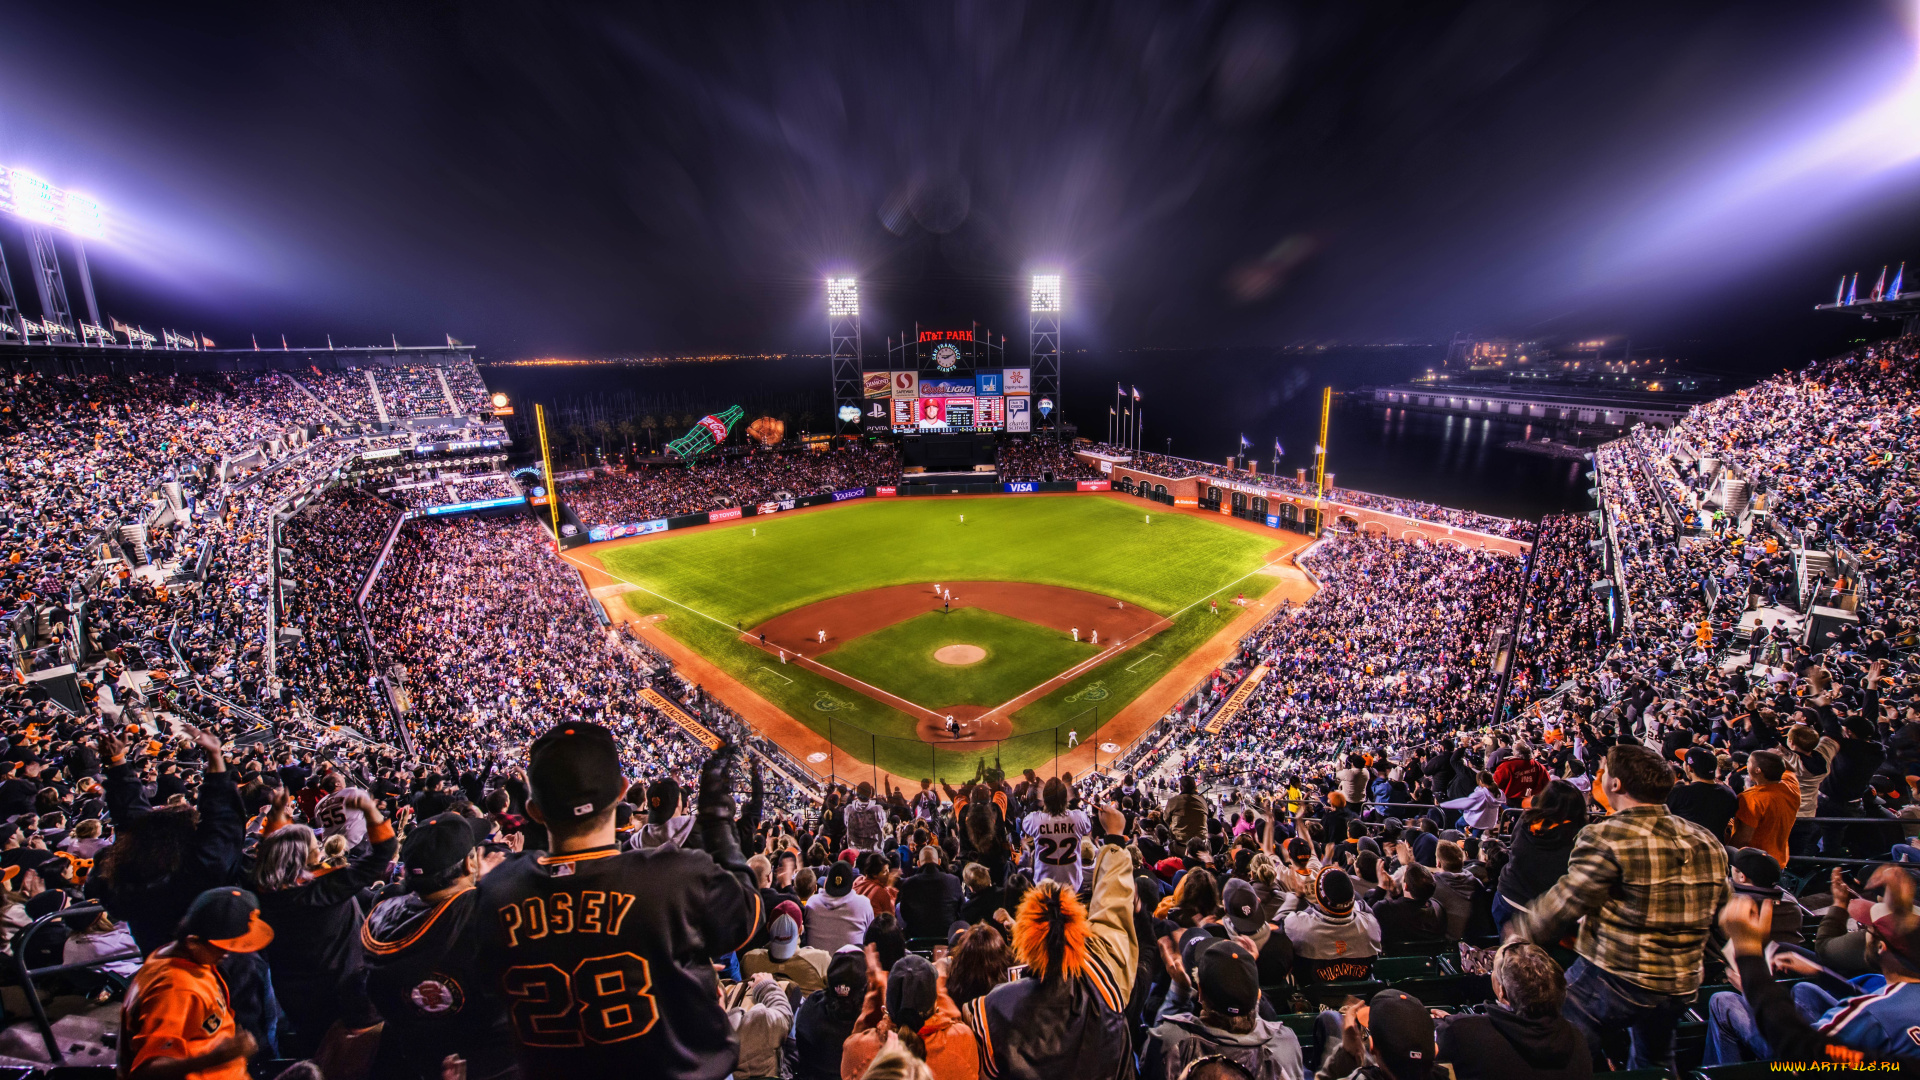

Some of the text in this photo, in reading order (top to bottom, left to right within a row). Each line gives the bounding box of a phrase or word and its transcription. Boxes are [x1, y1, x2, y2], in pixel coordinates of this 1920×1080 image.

[918, 330, 973, 343] AT&T PARK
[931, 342, 961, 361] SAN FRANCISCO
[936, 364, 957, 373] GIANTS
[865, 378, 889, 388] DIAMOND
[946, 385, 973, 393] LIGHT
[510, 466, 541, 479] Ghirardelli
[1010, 483, 1033, 492] VISA
[1231, 483, 1268, 498] LANDING
[719, 510, 741, 519] TOYOTA
[1209, 707, 1235, 729] WELCOME
[1228, 700, 1240, 708] TO
[1241, 680, 1257, 692] PARK
[648, 694, 662, 706] SAN
[657, 701, 691, 725] FRANCISCO
[685, 722, 712, 741] GIANTS
[320, 805, 347, 829] 55
[1039, 822, 1076, 835] CLARK
[1037, 836, 1079, 867] 22
[498, 890, 636, 948] POSEY
[1315, 962, 1369, 982] GIANTS
[502, 951, 660, 1048] 28
